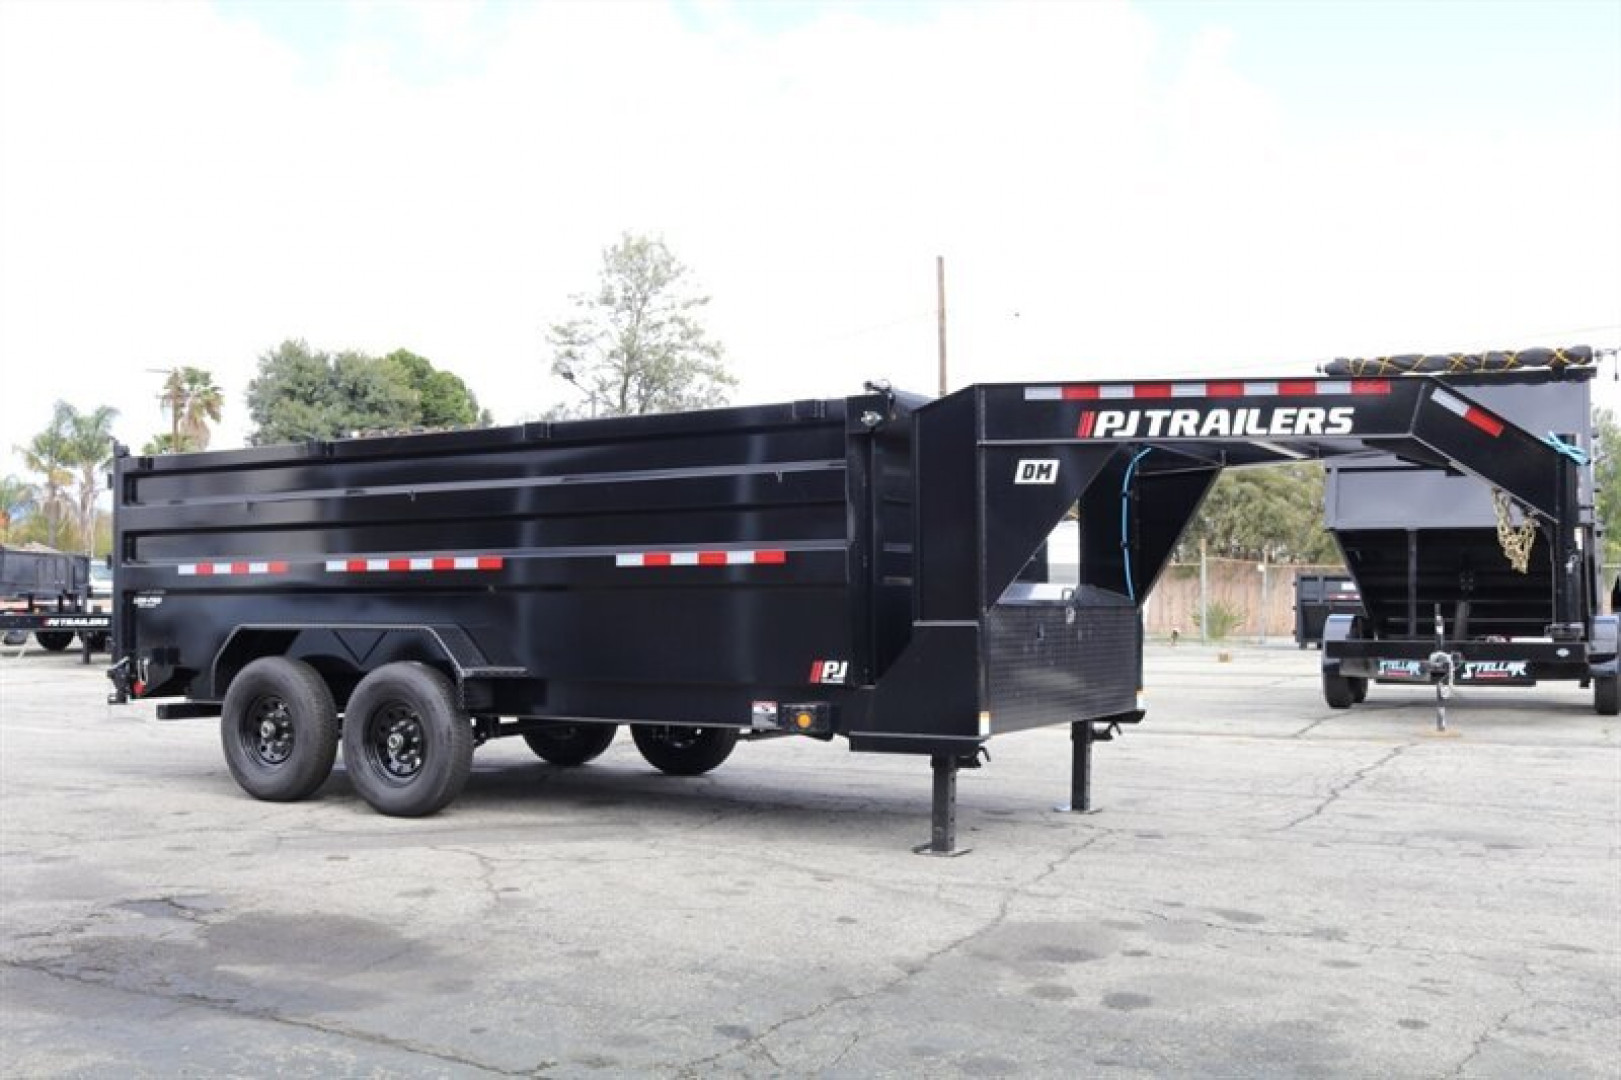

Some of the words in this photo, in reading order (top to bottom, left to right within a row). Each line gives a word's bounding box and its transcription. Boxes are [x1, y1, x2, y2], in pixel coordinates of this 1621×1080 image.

[1093, 410, 1140, 437] PJ
[1144, 407, 1354, 437] TRAILERS
[822, 660, 848, 678] PJ
